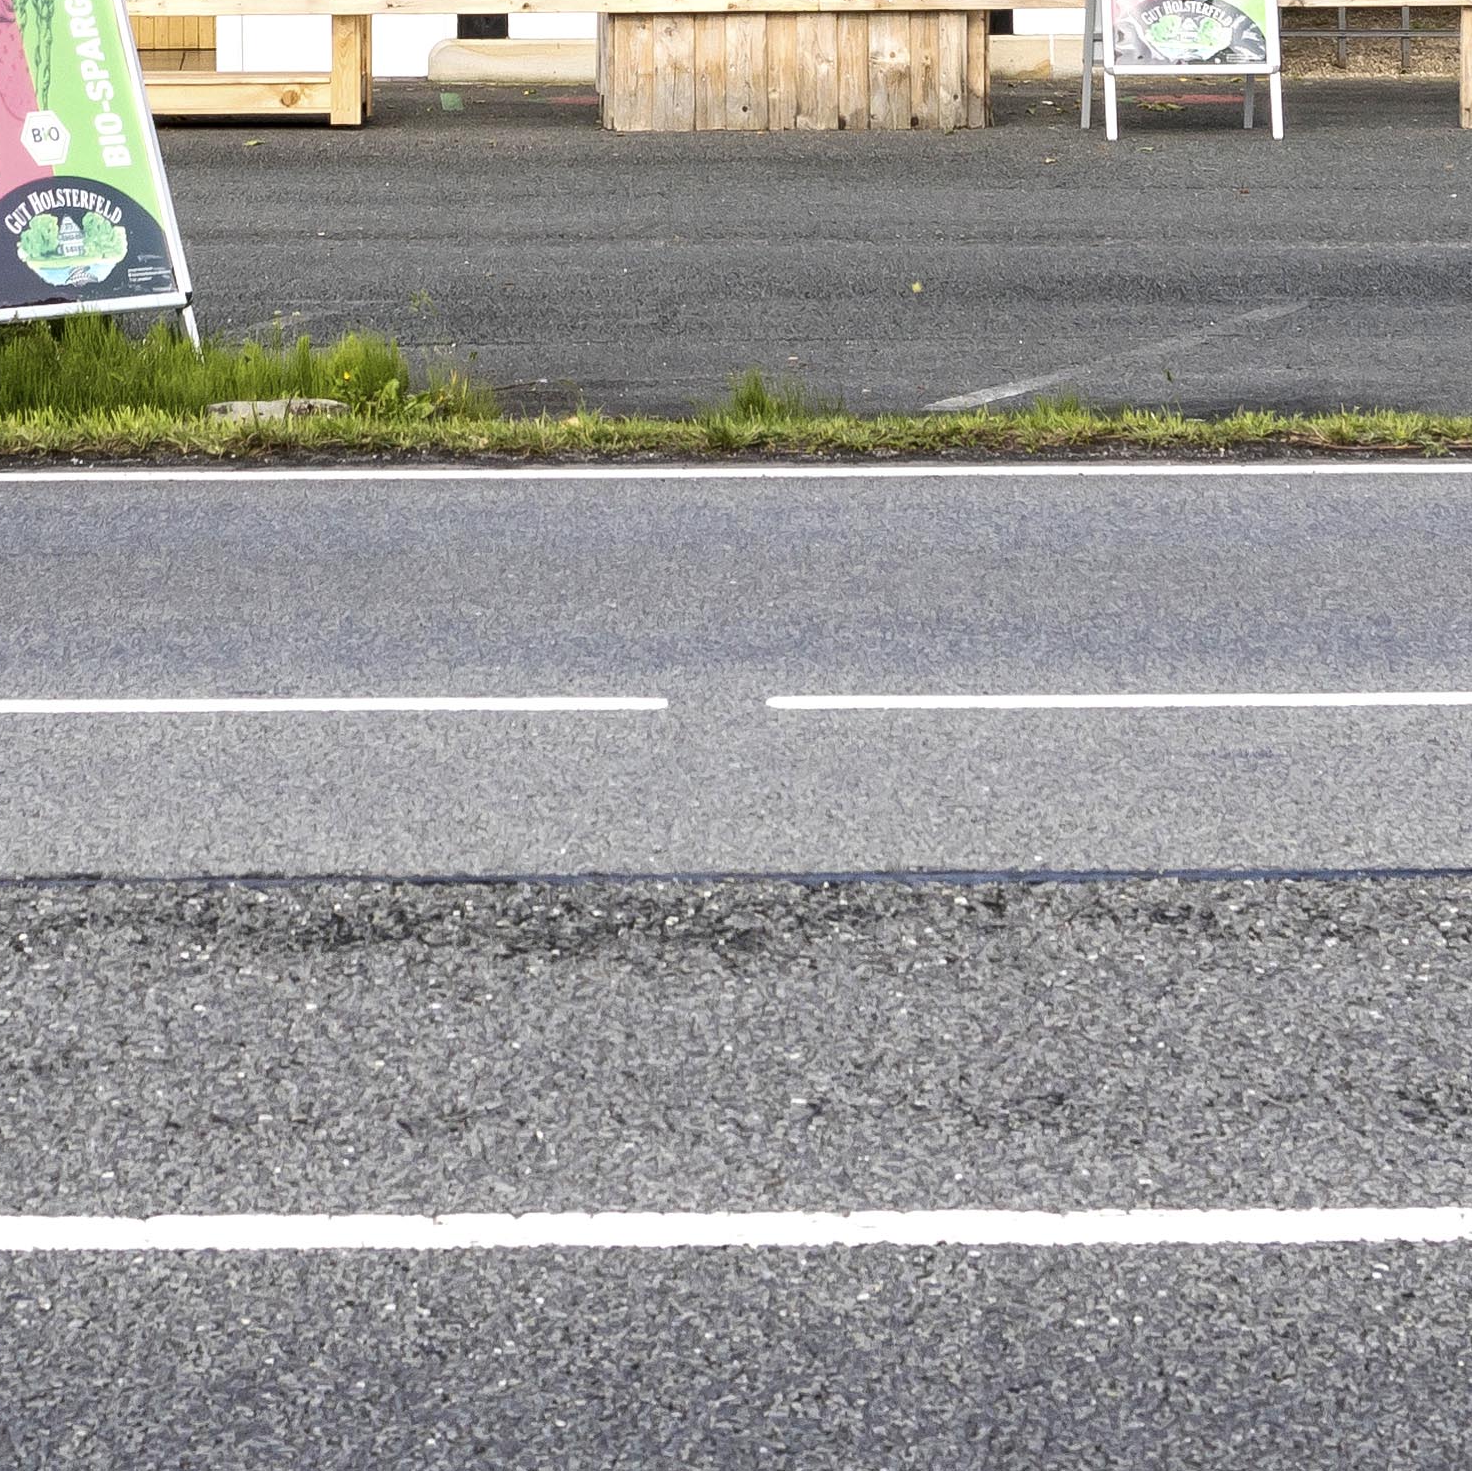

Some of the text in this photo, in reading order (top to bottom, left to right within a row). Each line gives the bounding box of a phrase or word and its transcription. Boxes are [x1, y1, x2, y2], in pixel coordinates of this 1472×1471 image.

[1141, 0, 1234, 27] GUT HOLSTERFELD
[4, 187, 124, 236] GUT HOLSTERFELD
